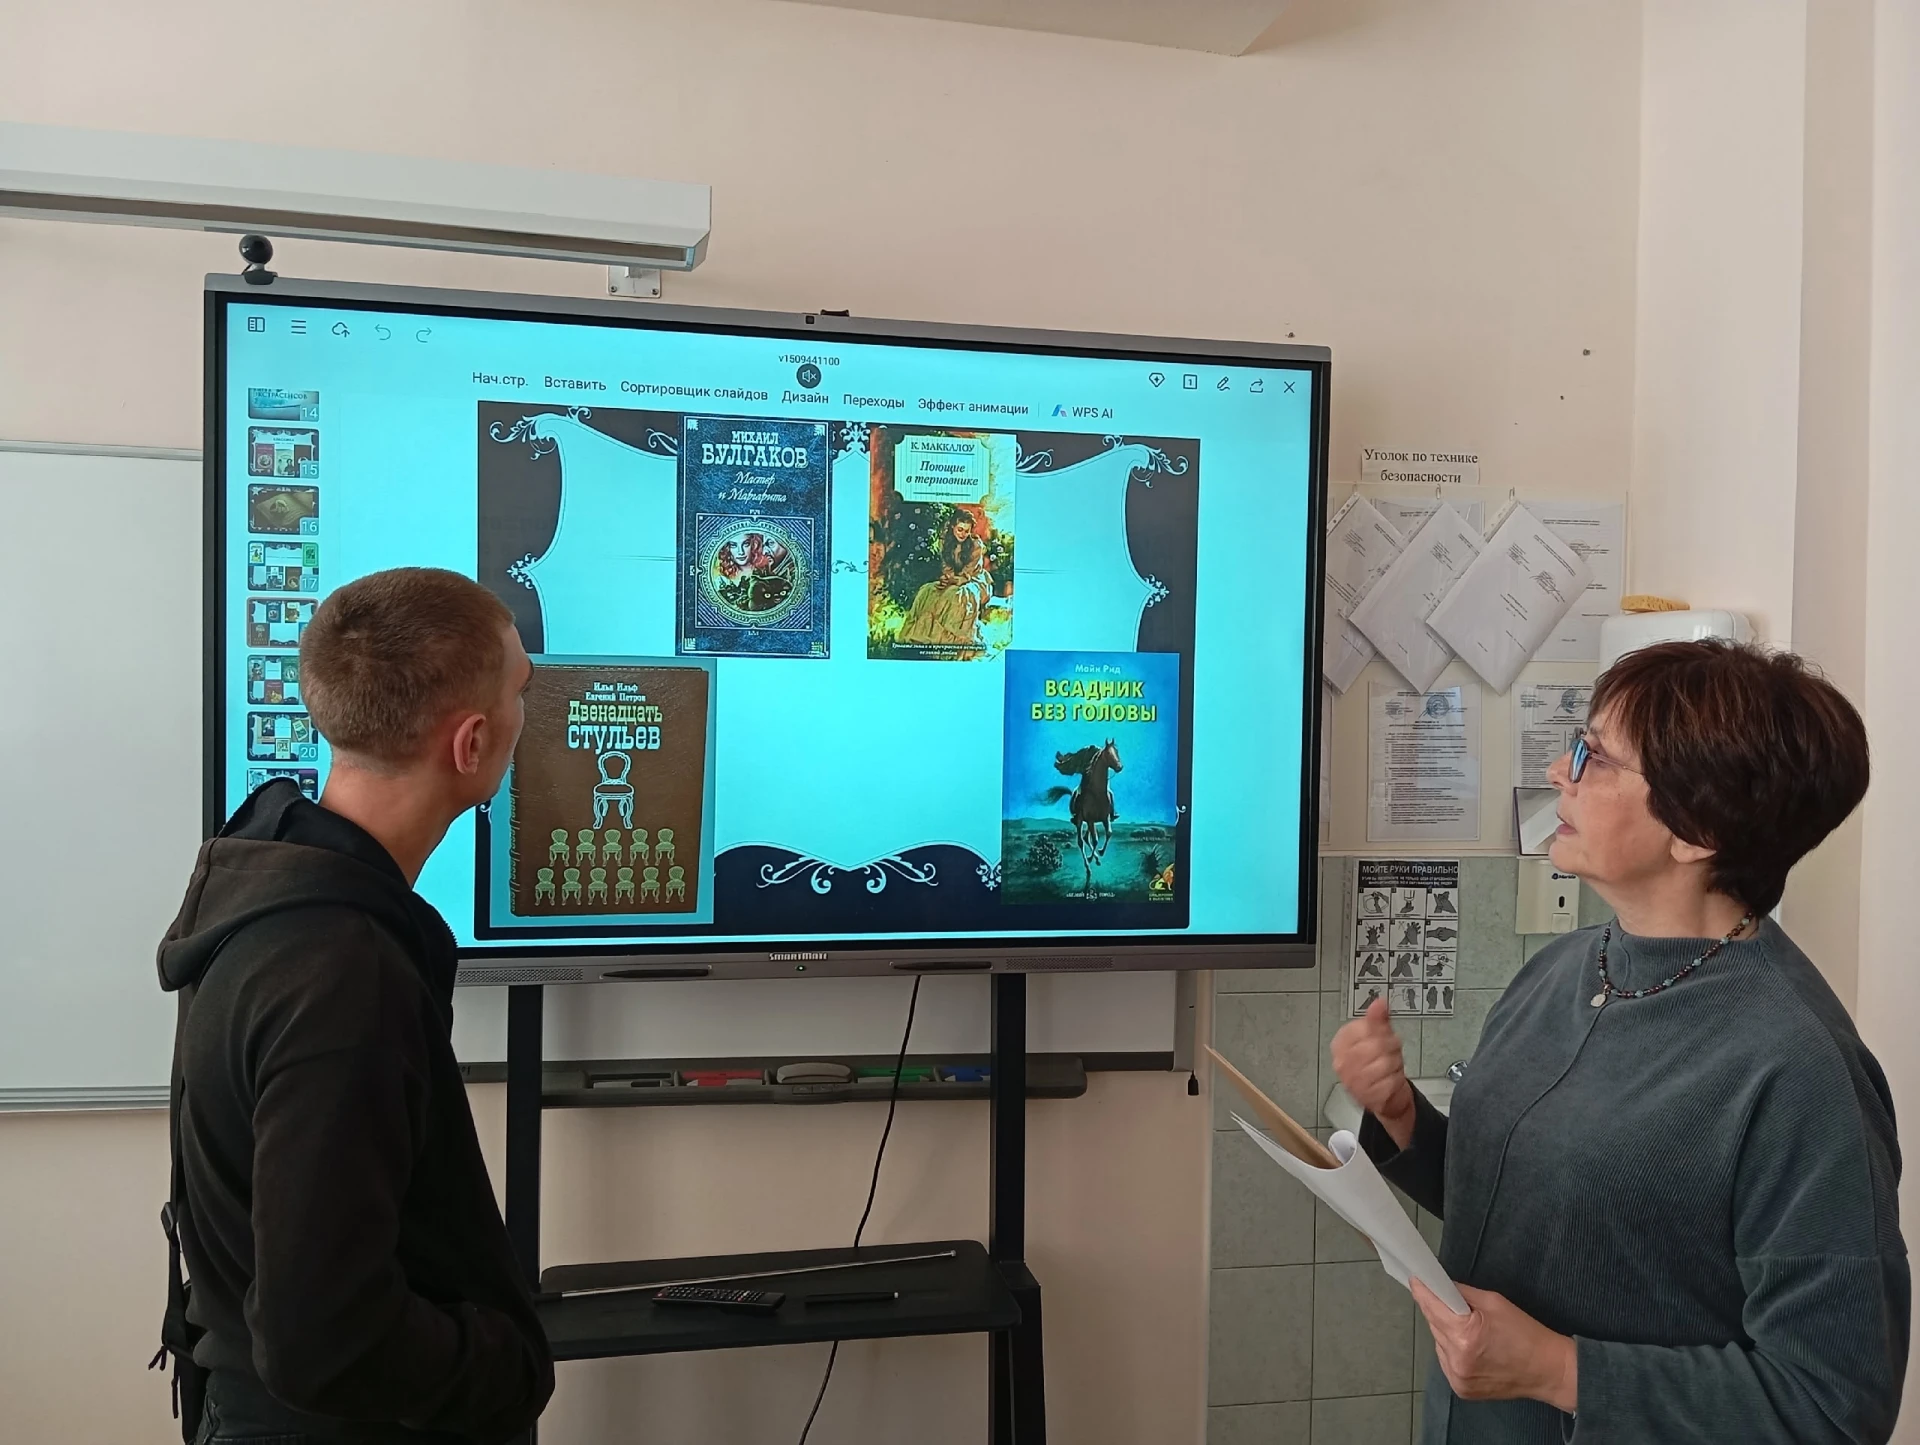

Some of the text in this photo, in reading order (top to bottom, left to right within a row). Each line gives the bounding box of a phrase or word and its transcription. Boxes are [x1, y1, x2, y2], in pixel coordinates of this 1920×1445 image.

[778, 354, 840, 366] v1509441100
[472, 372, 529, 388] Нач.стр.
[544, 376, 607, 391] Вставить
[620, 380, 768, 401] Сортировщик слайдов
[782, 390, 829, 405] Дизайн
[843, 394, 905, 409] Переходы
[918, 398, 1029, 416] Эффект анимации
[302, 407, 319, 418] 14
[1072, 406, 1113, 419] WPS AI
[731, 430, 779, 445] МИХАИЛ
[911, 441, 975, 453] К. МАККАЛОУ
[701, 443, 808, 469] БУЛГАКОВ
[1364, 448, 1478, 464] Уголок по технике
[302, 464, 318, 476] 15
[919, 460, 966, 474] Поющие
[733, 471, 776, 488] Мастер
[906, 475, 979, 487] в терновнике
[1380, 469, 1461, 483] безопасности
[718, 488, 787, 504] и Маргарита
[302, 521, 318, 533] 16
[302, 577, 317, 590] 17
[1075, 663, 1121, 674] Майн Рид
[593, 682, 638, 693] Илья Ильф
[1045, 679, 1145, 700] ВСАДНИК
[585, 691, 646, 703] Евгений Петров
[568, 700, 663, 725] Двенадцать
[1031, 703, 1157, 722] БЕЗ ГОЛОВЫ
[300, 746, 317, 758] 20
[1362, 864, 1458, 874] МОЙТЕ РУКИ ПРАВИЛЬНО
